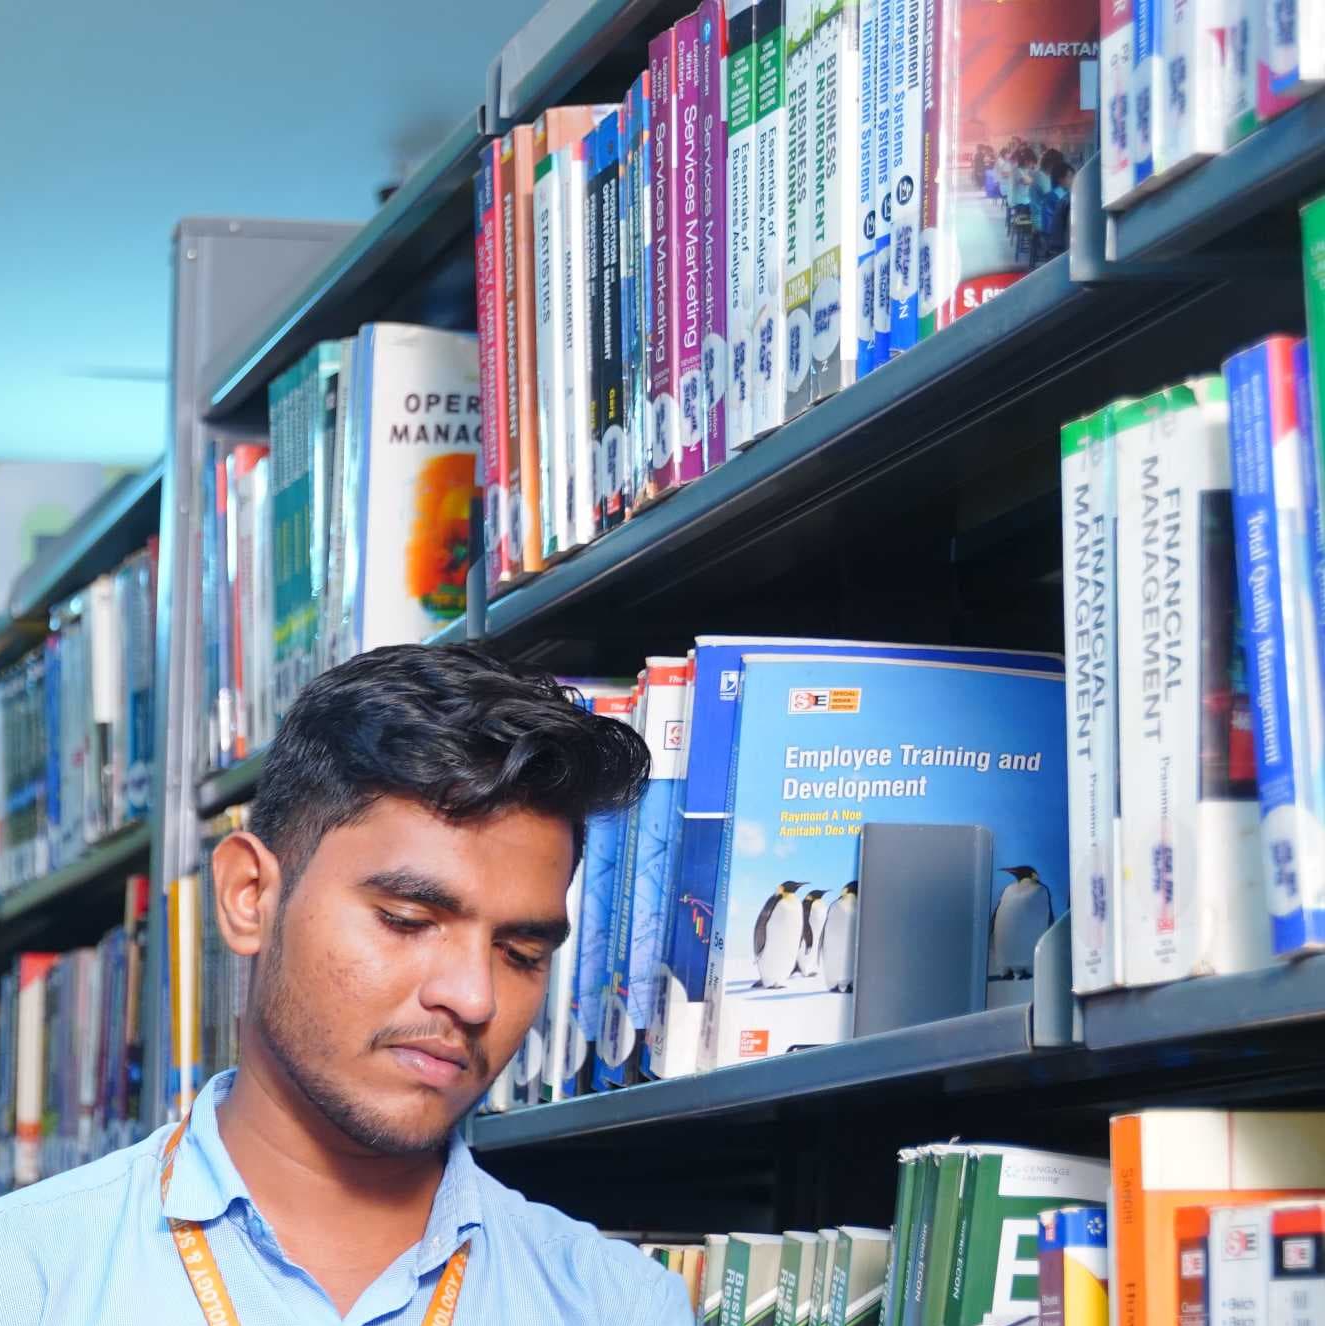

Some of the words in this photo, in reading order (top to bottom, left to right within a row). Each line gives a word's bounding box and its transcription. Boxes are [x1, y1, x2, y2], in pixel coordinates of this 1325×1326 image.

[860, 19, 873, 127] Information
[1029, 42, 1099, 58] MARTAN
[683, 103, 698, 216] Services
[795, 81, 807, 205] BUSINESS
[815, 61, 827, 243] ENVIRONMENT
[825, 51, 838, 181] BUSINESS
[655, 121, 666, 233] Services
[731, 147, 740, 228] Business
[740, 141, 750, 228] Essentials
[756, 133, 767, 212] Business
[765, 126, 777, 219] Essentials
[786, 88, 798, 266] ENVIRONMENT
[860, 128, 872, 205] Systems
[539, 208, 551, 324] STATISTICS
[730, 231, 740, 308] Analytics
[741, 230, 750, 253] of
[756, 214, 767, 297] Analytics
[766, 220, 776, 239] of
[655, 236, 669, 363] Marketing
[684, 218, 700, 350] Marketing
[404, 394, 480, 415] OPER
[1247, 509, 1268, 562] Total
[1073, 483, 1092, 761] MANAGEMENT
[1091, 514, 1108, 721] FINANCIAL
[1141, 455, 1161, 744] MANAGEMENT
[1163, 487, 1182, 702] FINANCIAL
[1249, 565, 1273, 633] Quality
[1256, 638, 1280, 765] Management
[782, 775, 928, 802] Development
[784, 746, 893, 772] Employee
[900, 744, 992, 773] Training
[998, 751, 1042, 772] and
[779, 824, 822, 837] Amitabh
[824, 825, 845, 837] Deo
[848, 825, 862, 837] Ko
[780, 810, 830, 824] Raymond
[831, 811, 839, 821] A
[841, 810, 862, 821] Noe
[1022, 1166, 1070, 1177] CENGAGE
